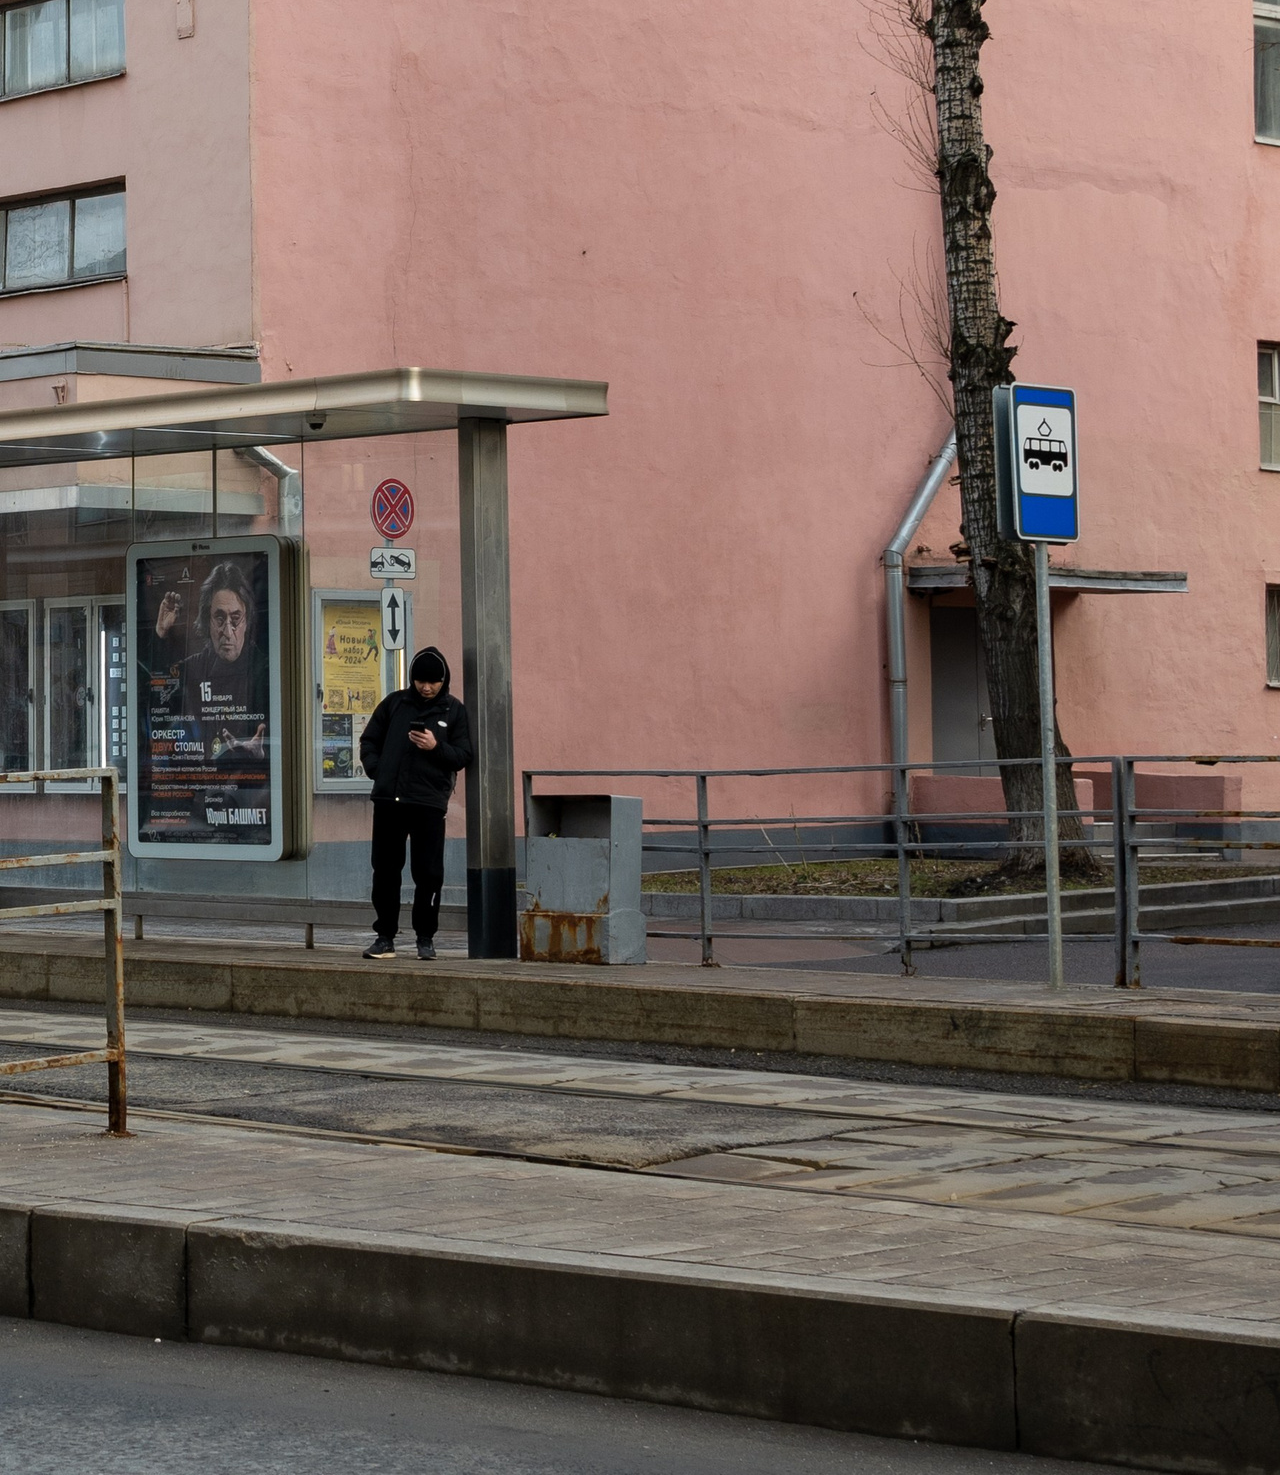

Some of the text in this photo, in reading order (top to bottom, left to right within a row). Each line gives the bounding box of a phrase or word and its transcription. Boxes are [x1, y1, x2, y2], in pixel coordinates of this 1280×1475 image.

[339, 634, 367, 644] Новый
[343, 647, 365, 655] набор
[200, 681, 233, 702] 15 ЯНВАРЯ
[201, 705, 236, 713] КОНЦЕРТНЫЙ
[151, 729, 186, 739] ОРКЕСТР
[151, 741, 204, 752] ДВУХ СТОЛИЦ
[205, 807, 267, 826] Юрий БАШМЕТ
